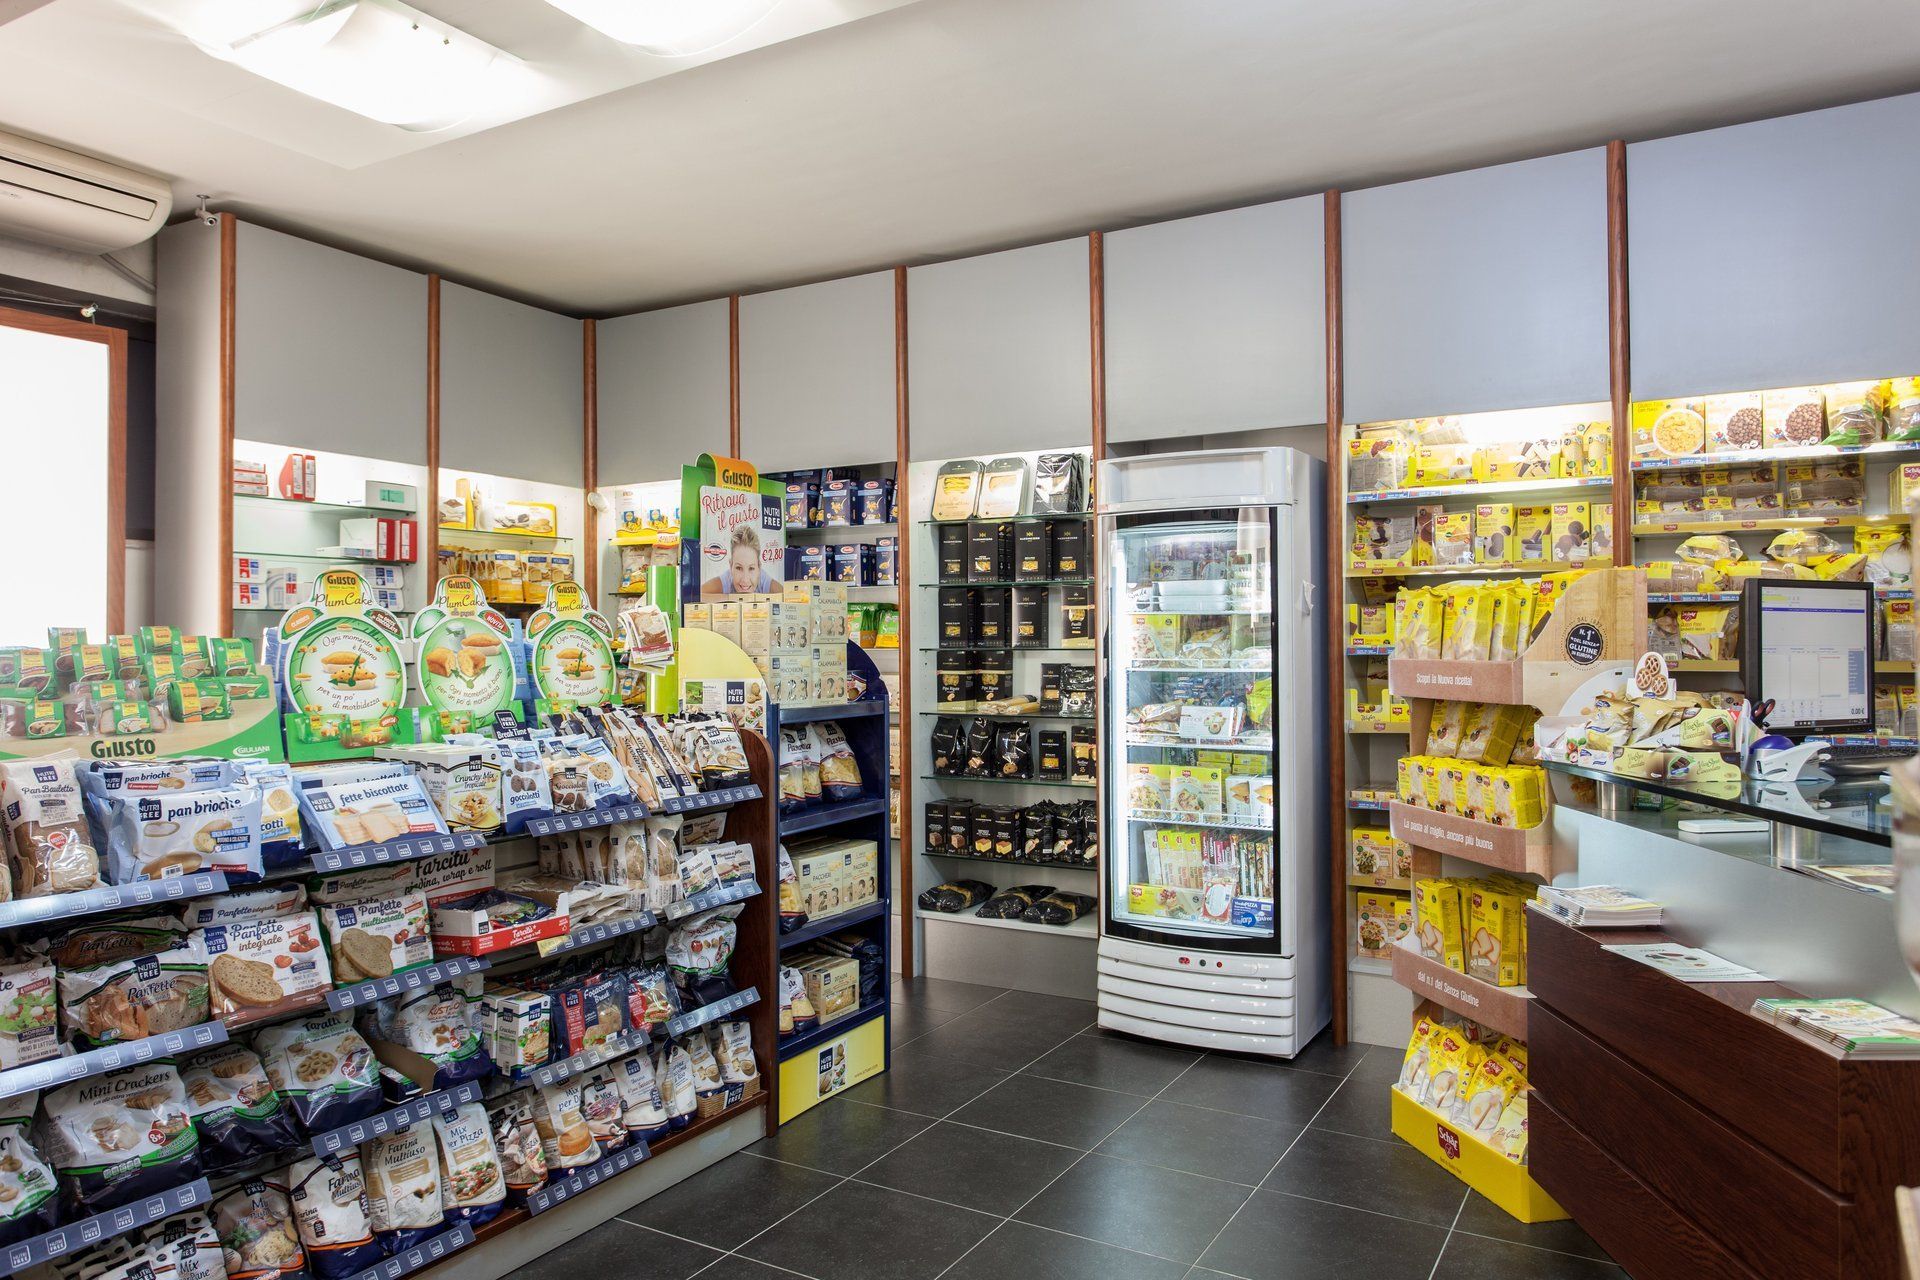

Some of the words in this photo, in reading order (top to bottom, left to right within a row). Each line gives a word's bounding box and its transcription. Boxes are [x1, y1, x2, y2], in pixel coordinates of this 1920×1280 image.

[722, 469, 753, 488] Giusto
[702, 493, 746, 514] Ritrova
[763, 506, 780, 518] NUTRI
[717, 511, 727, 532] il
[728, 506, 759, 532] gusto
[764, 516, 781, 527] FREE
[762, 548, 783, 562] €2,80
[327, 575, 356, 586] Giusto
[448, 580, 471, 590] Giusto
[556, 586, 577, 594] Giusto
[315, 592, 373, 607] PlumCake
[438, 594, 486, 608] PlumCake
[549, 600, 590, 612] PlumCake
[322, 636, 342, 648] Ogni
[342, 634, 373, 648] momento
[1570, 643, 1598, 656] GLUTINE
[1416, 674, 1430, 684] Scopri
[1432, 674, 1436, 683] la
[1438, 674, 1454, 685] Nuova
[1454, 676, 1472, 686] ricetta!
[317, 686, 330, 697] per
[342, 697, 380, 711] morbidezza
[496, 729, 514, 740] Break
[514, 728, 528, 736] Time
[91, 739, 156, 758] Giusto
[237, 746, 270, 754] GIULIANI
[124, 775, 140, 784] pan
[141, 771, 170, 781] brioche
[454, 774, 482, 784] Crunchy
[482, 772, 494, 780] Mix
[22, 786, 40, 794] Pan
[41, 784, 74, 794] Bauletto
[339, 794, 363, 806] fette
[365, 782, 410, 798] biscottate
[312, 798, 330, 806] NUTRI
[314, 804, 334, 812] FREE
[168, 806, 196, 821] pan
[1404, 818, 1410, 828] La
[1410, 822, 1422, 832] pasta
[1424, 824, 1428, 833] al
[1430, 826, 1446, 839] miglio,
[1446, 830, 1464, 842] ancora
[1475, 836, 1494, 850] buona
[442, 872, 466, 883] wrap
[476, 860, 492, 872] roll
[217, 906, 252, 918] Panfette
[359, 900, 402, 916] Panfette
[341, 918, 356, 926] FREE
[230, 924, 285, 942] Panfette
[206, 938, 225, 946] NUTRI
[208, 944, 227, 952] FREE
[239, 935, 282, 952] integrale
[138, 962, 158, 972] NUTRI
[140, 968, 160, 980] FREE
[1418, 971, 1426, 982] dal
[1434, 980, 1442, 991] del
[1443, 984, 1460, 998] Senza
[1460, 990, 1480, 1008] Glutine
[820, 1062, 832, 1072] FREE
[79, 1082, 112, 1103] Mini
[114, 1070, 170, 1092] Crackers
[566, 1087, 578, 1097] Mix
[729, 1094, 742, 1104] FREE
[558, 1100, 572, 1112] per
[450, 1125, 467, 1136] Mix
[459, 1128, 484, 1145] Pizza
[150, 1131, 164, 1144] 8x
[1438, 1126, 1458, 1151] Schär
[388, 1138, 418, 1154] Farina
[384, 1146, 426, 1166] Multiuso
[180, 1260, 199, 1272] Mix
